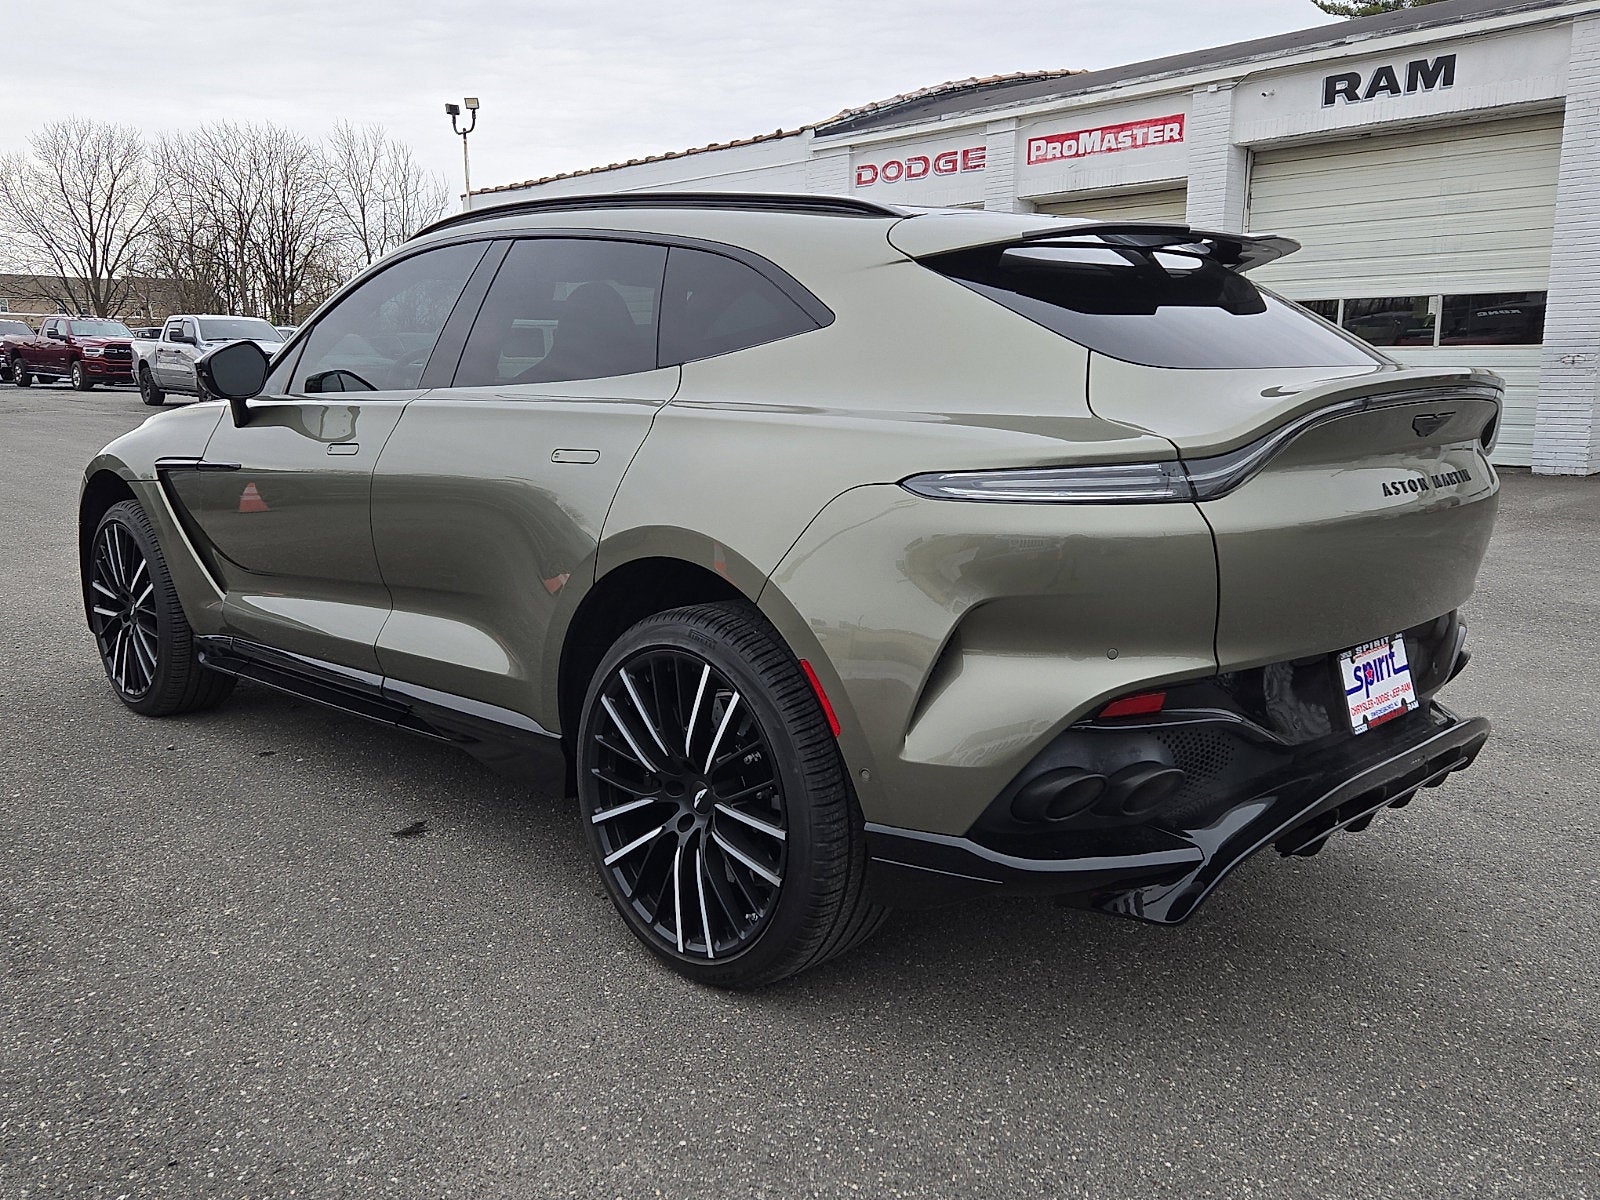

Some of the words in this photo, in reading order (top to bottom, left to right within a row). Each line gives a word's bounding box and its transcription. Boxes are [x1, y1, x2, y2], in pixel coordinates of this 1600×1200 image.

[1321, 54, 1457, 108] RAM
[856, 146, 987, 188] DODGE
[1381, 477, 1430, 497] ASTON
[1430, 468, 1472, 489] MARTIN
[1355, 636, 1390, 655] SPIRIT
